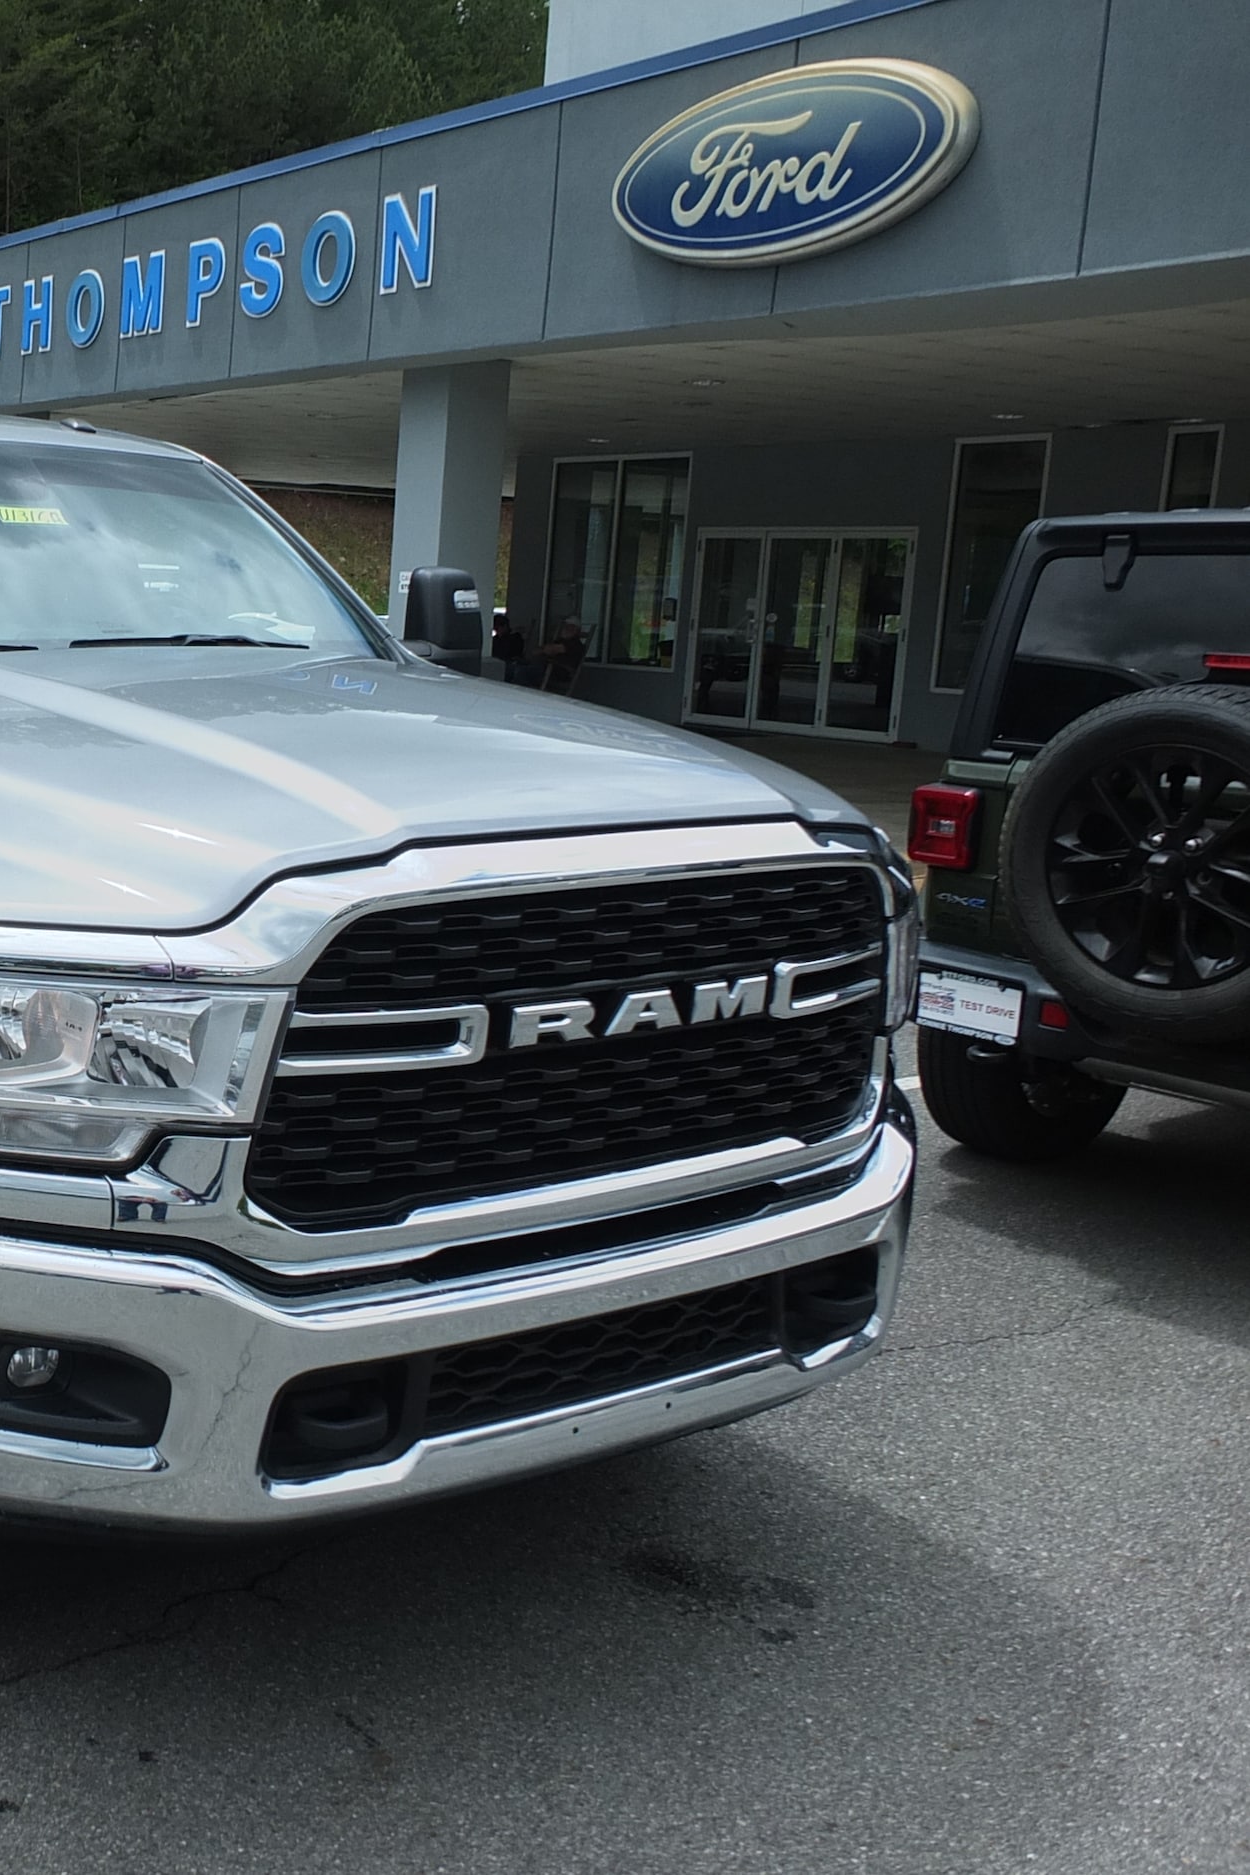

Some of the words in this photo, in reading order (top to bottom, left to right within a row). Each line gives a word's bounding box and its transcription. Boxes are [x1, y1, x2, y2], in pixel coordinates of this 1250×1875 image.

[671, 109, 863, 228] Ford
[508, 974, 769, 1050] RAM
[959, 999, 984, 1012] TEST
[985, 1005, 1016, 1020] DRIVE
